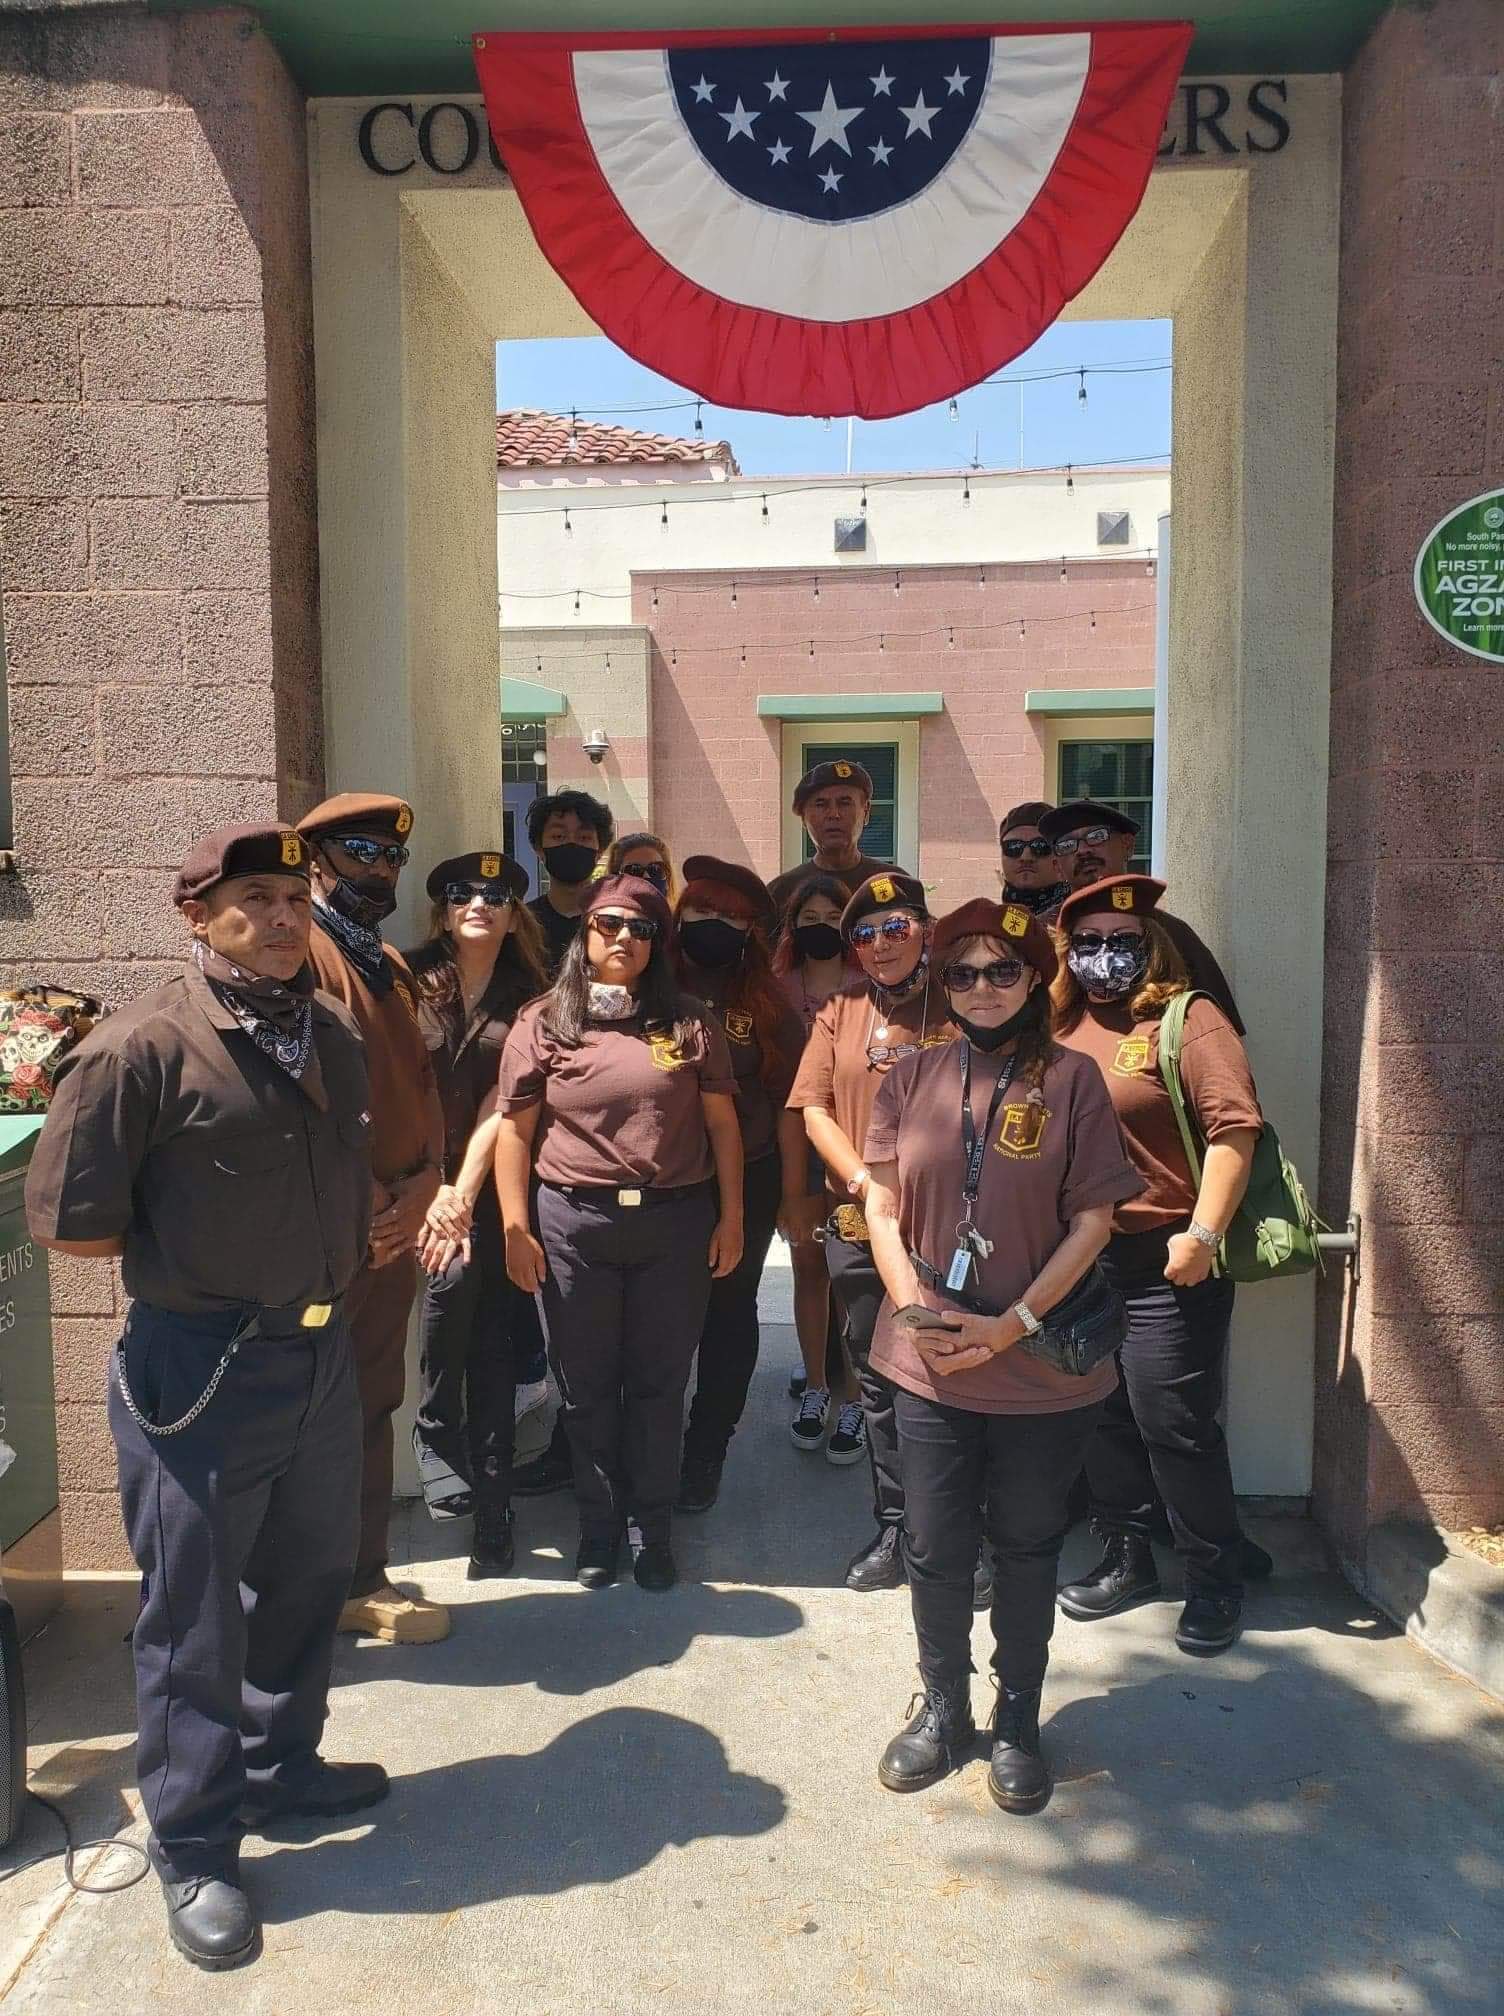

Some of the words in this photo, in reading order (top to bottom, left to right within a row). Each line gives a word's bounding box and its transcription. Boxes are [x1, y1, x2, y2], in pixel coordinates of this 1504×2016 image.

[1466, 532, 1489, 541] South
[1445, 542, 1457, 551] No
[1437, 560, 1490, 571] FIRST
[1463, 624, 1483, 632] Learn
